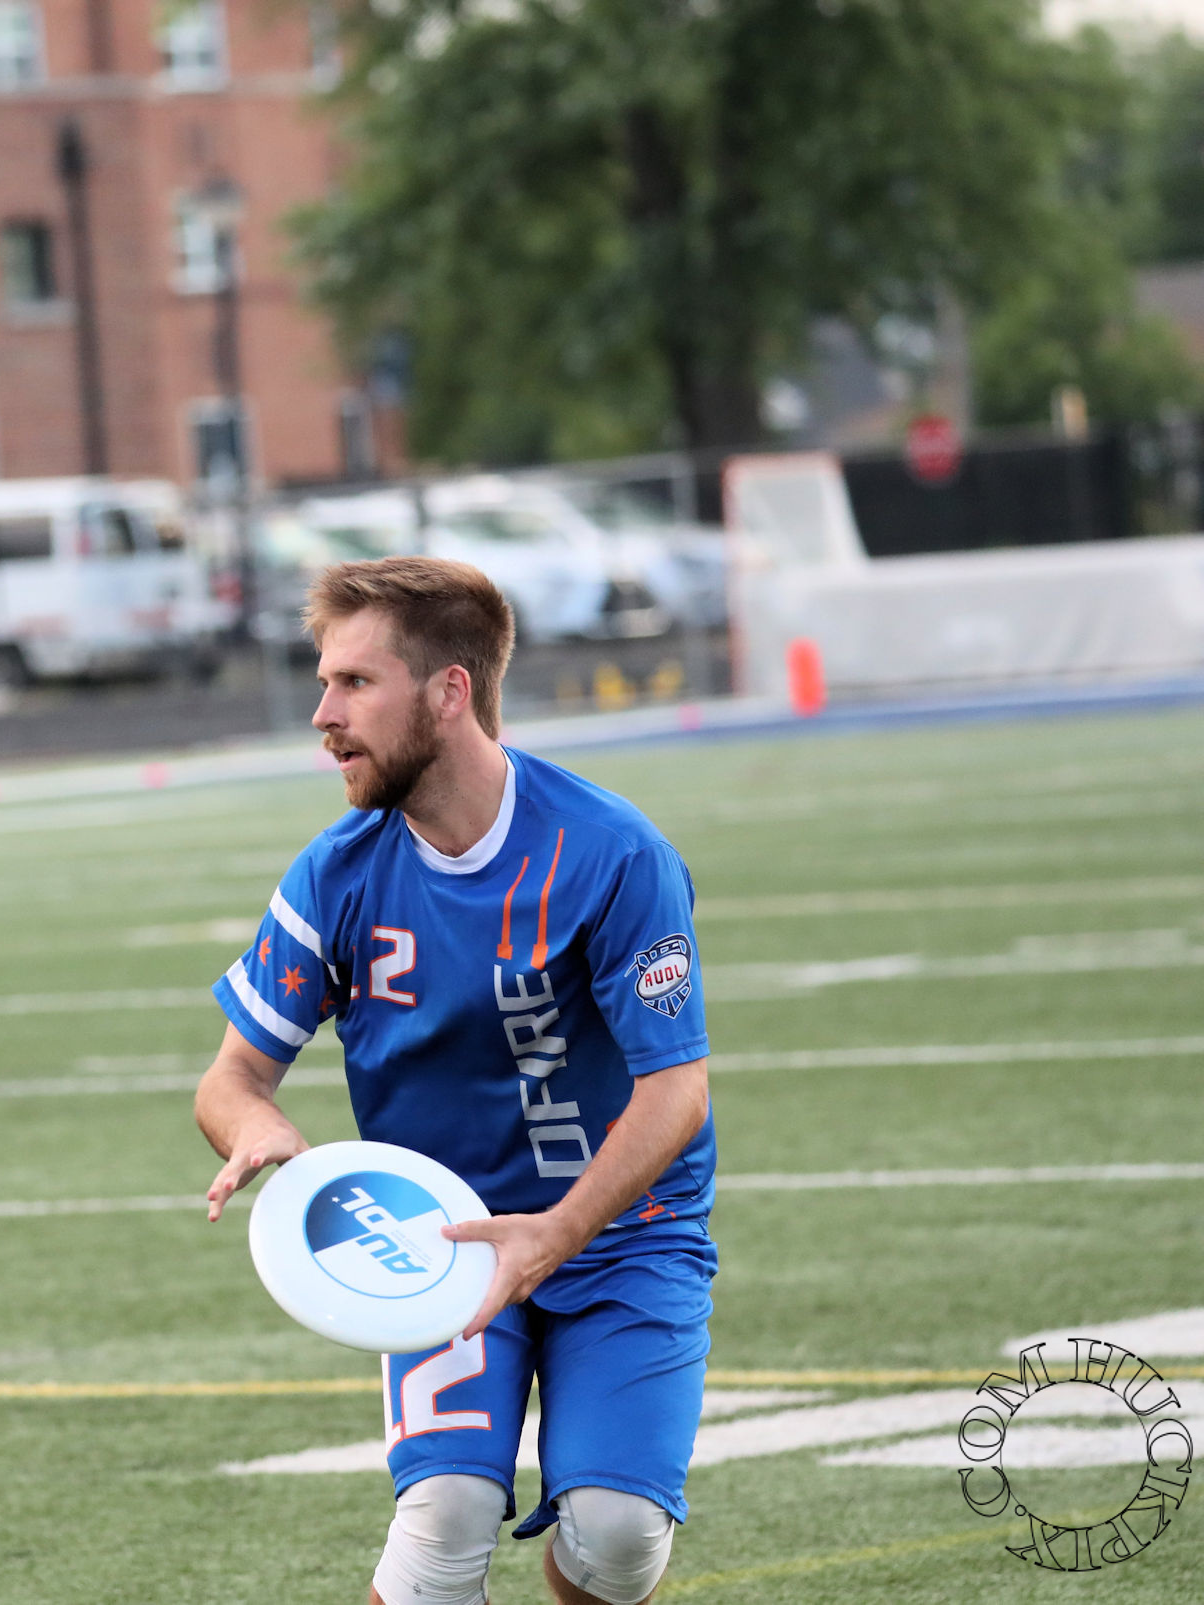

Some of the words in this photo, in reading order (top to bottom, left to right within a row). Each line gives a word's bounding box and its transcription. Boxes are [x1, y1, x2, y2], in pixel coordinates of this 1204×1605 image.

[350, 925, 417, 1008] 2
[644, 964, 683, 988] AUDL
[340, 1186, 429, 1275] AUDL
